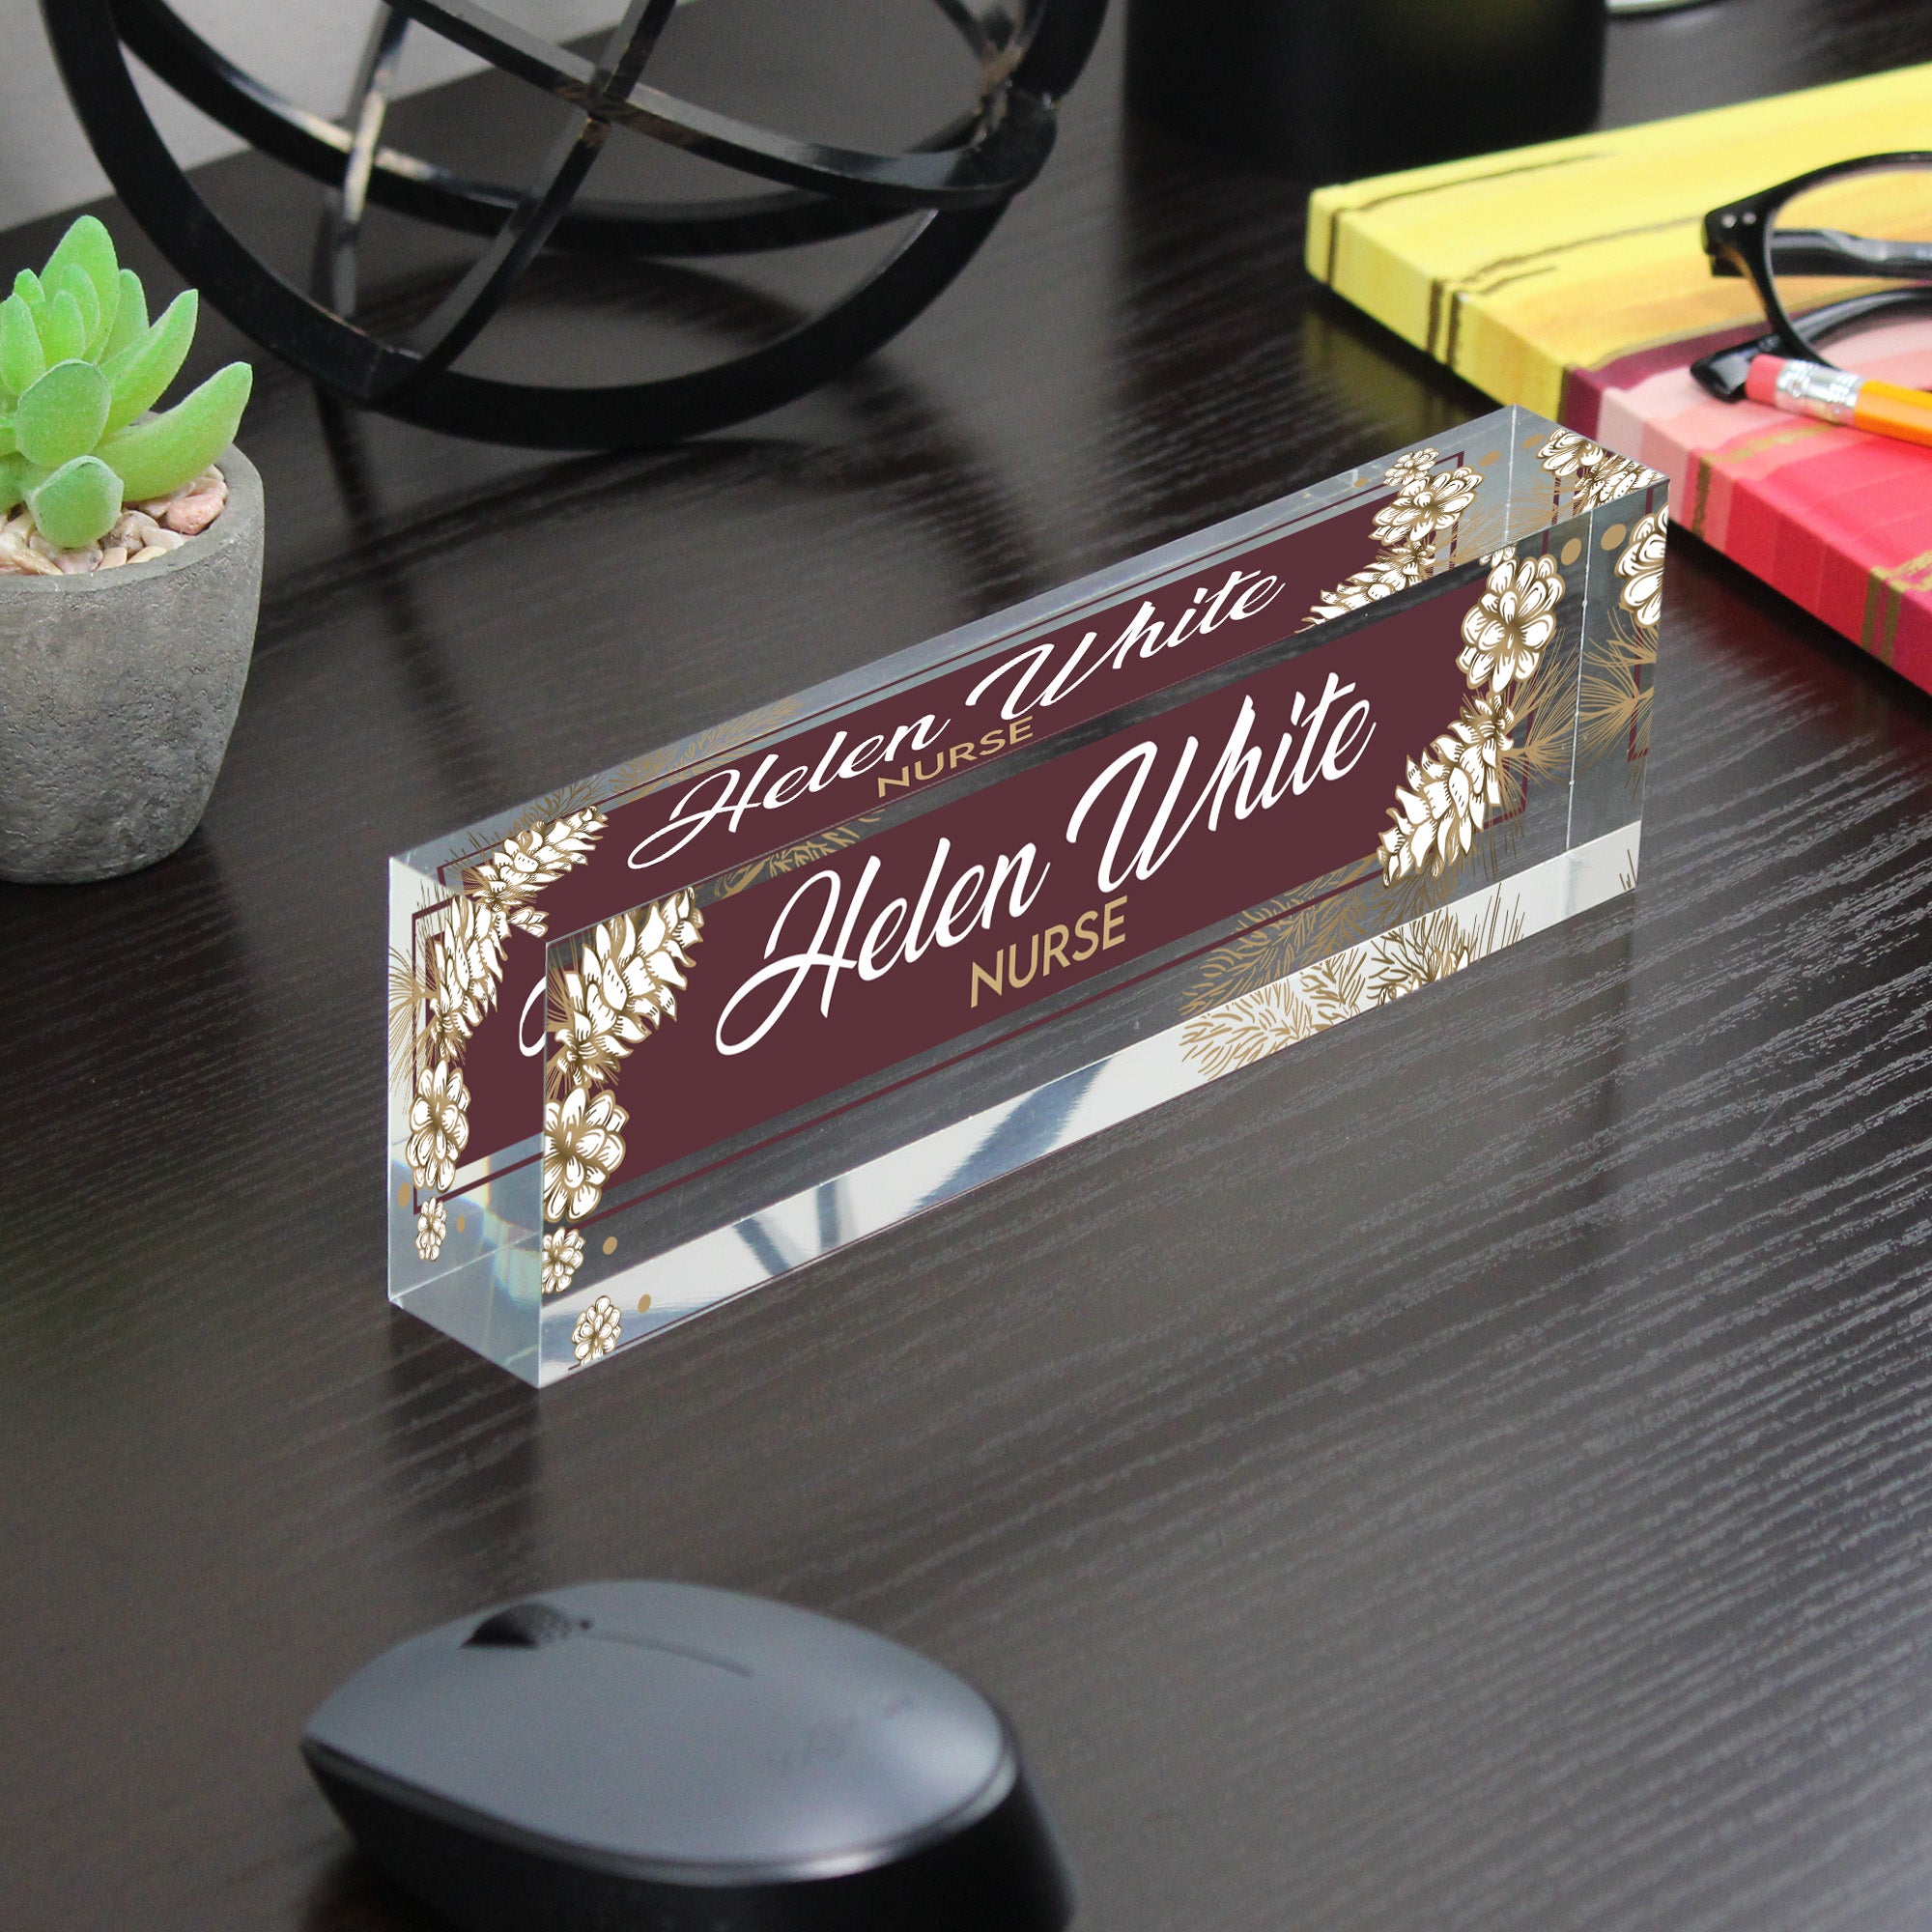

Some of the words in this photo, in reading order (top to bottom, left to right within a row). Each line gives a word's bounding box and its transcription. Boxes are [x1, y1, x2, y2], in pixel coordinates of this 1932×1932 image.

[627, 713, 952, 869] Helen
[964, 569, 1286, 722] White
[876, 715, 1034, 798] NURSE
[714, 836, 1051, 1057] Helen
[1065, 671, 1378, 895] White
[970, 895, 1128, 1009] NURSE
